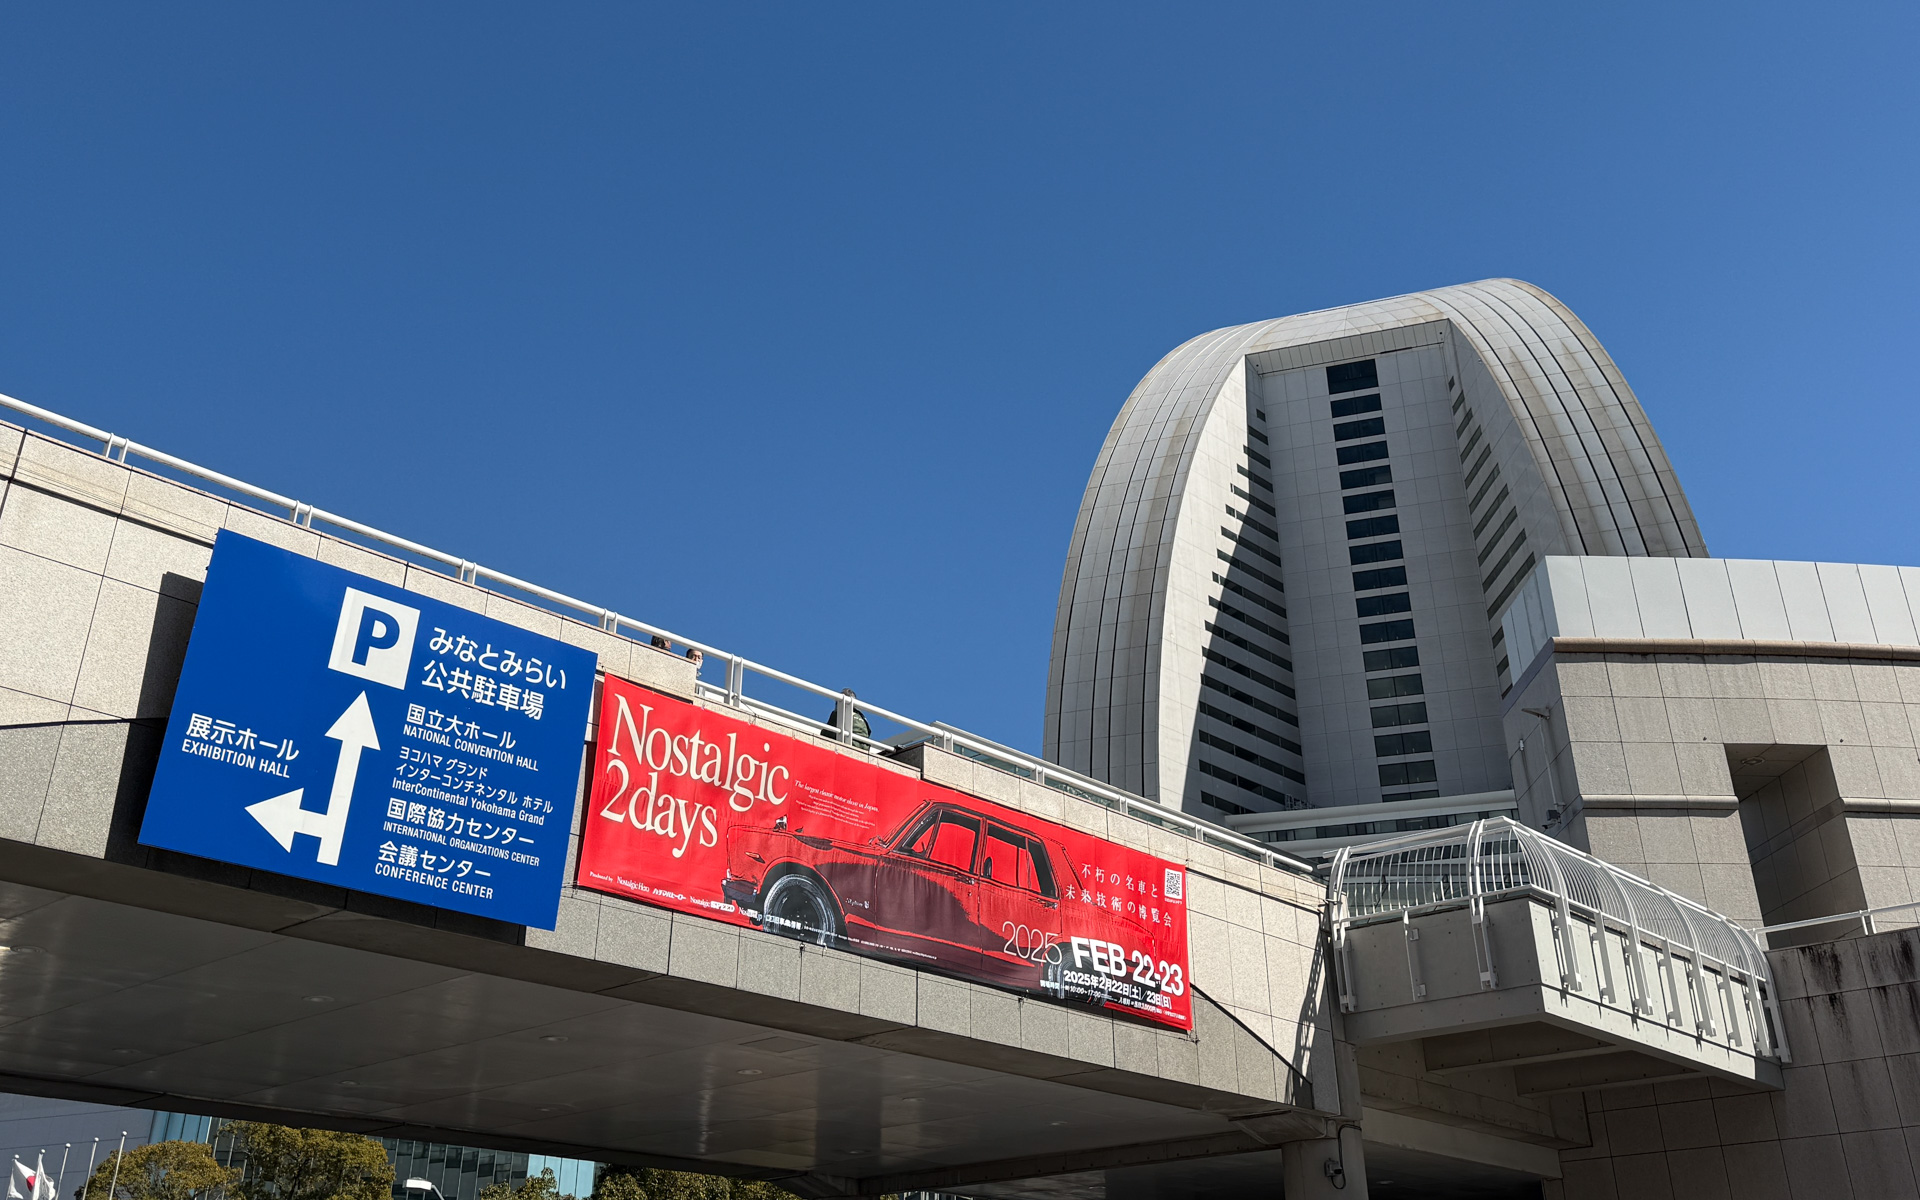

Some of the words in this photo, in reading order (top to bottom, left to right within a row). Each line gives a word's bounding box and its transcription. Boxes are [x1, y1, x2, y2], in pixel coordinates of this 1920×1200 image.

[350, 605, 401, 666] P
[429, 627, 567, 690] みなとみらい
[421, 659, 545, 721] 公共駐車場
[185, 713, 300, 762] 展示ホール
[403, 724, 451, 747] NATIONAL
[454, 738, 514, 765] CONVENTION
[516, 756, 539, 771] HALL
[406, 703, 516, 749] 国立大ホール
[181, 739, 257, 770] EXHIBITION
[258, 758, 291, 778] HALL
[399, 746, 443, 768] ヨコハマ
[446, 758, 488, 780] グランド
[607, 693, 789, 812] Nostalgic
[392, 777, 468, 807] InterContinental
[471, 797, 516, 819] Yokohama
[519, 810, 545, 826] Grand
[396, 763, 518, 805] インターコンチネンタル
[522, 795, 553, 814] ホテル
[600, 759, 718, 858] 2days
[383, 821, 447, 846] INTERNATIONAL
[449, 839, 509, 860] ORGANIZATIONS
[511, 852, 540, 867] CENTER
[386, 797, 534, 845] 国際協力センター
[375, 862, 448, 890] CONFERENCE
[451, 880, 493, 900] CENTER
[377, 840, 491, 878] 会議センター
[1081, 863, 1158, 898] 不朽の名車と
[1065, 884, 1171, 928] 未来技術の博覧会
[1001, 920, 1063, 965] 2025
[1070, 936, 1127, 977] FEB
[1131, 950, 1184, 997] 22-23
